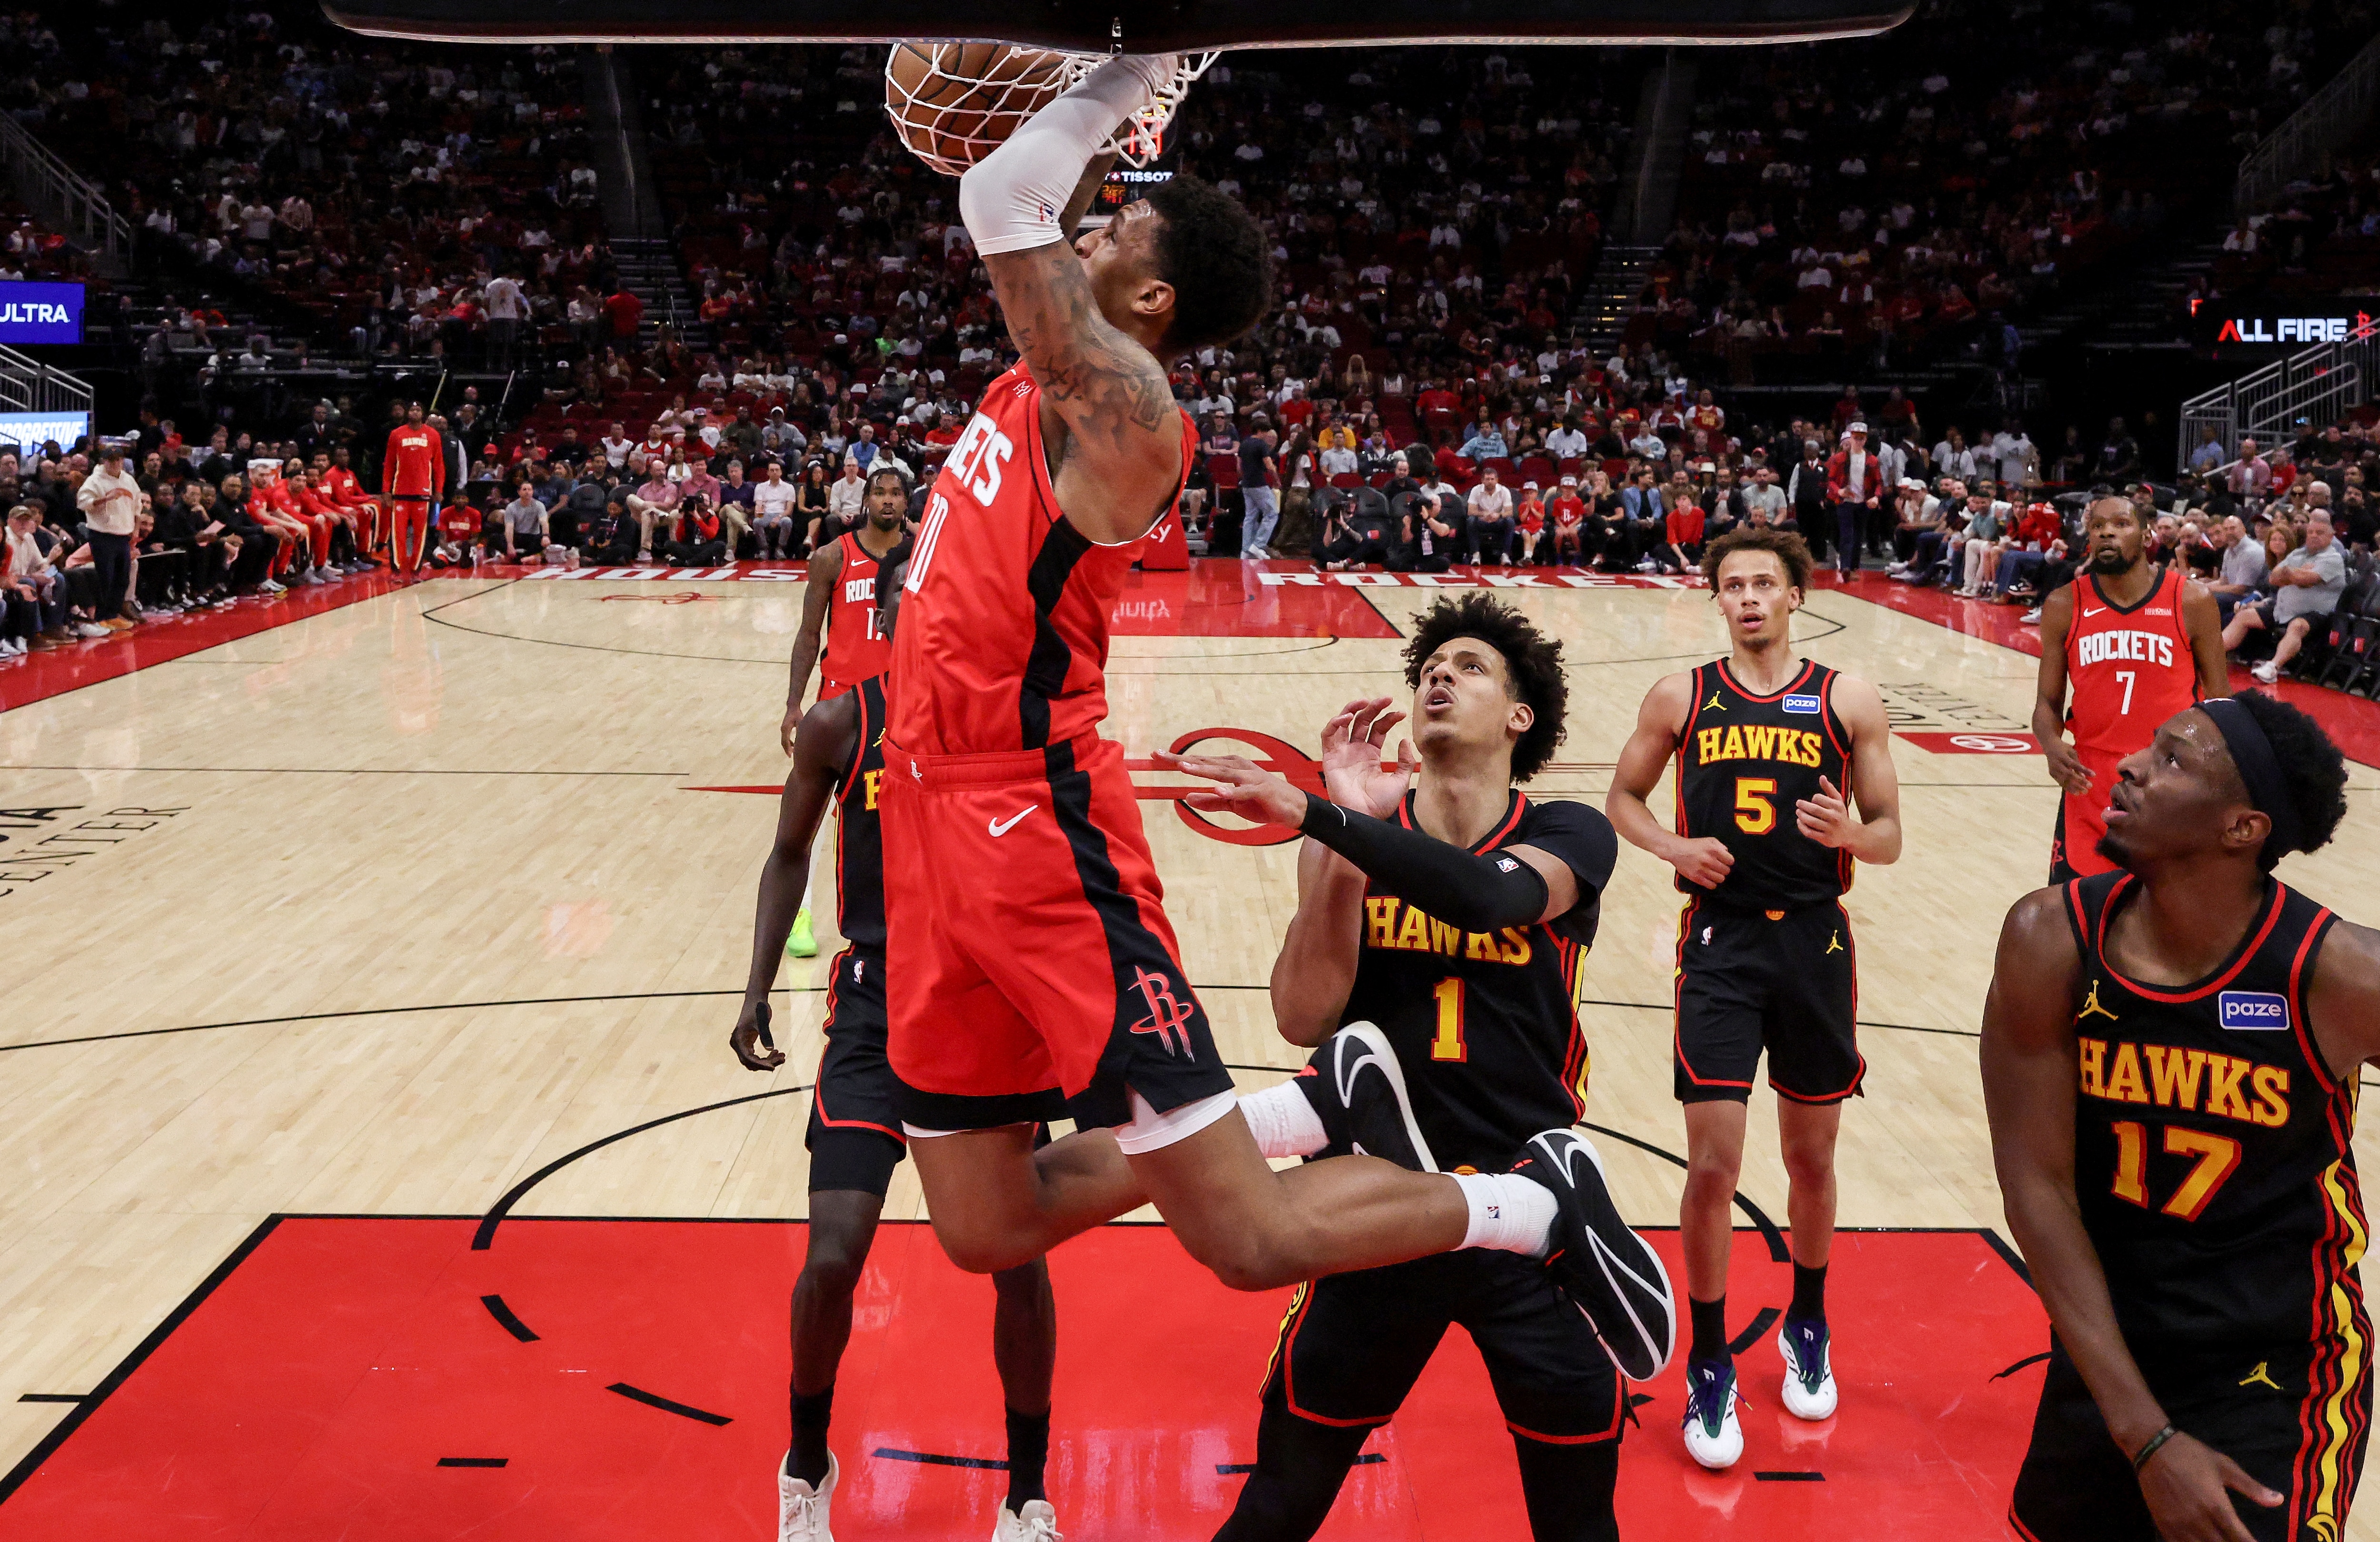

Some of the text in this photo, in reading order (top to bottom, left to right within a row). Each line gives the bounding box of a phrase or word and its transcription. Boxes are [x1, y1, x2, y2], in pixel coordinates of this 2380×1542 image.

[1121, 171, 1173, 182] TISSOT
[524, 568, 807, 582] HOUS
[846, 577, 876, 603] ROC
[1258, 573, 1709, 590] ROCKET
[867, 607, 883, 640] 1
[2078, 630, 2173, 667] ROCKETS
[1785, 698, 1817, 709] paze
[2116, 671, 2136, 715] 7
[1697, 725, 1822, 768] HAWKS
[1734, 777, 1777, 835] 5
[0, 806, 191, 898] ENTER
[1431, 976, 1467, 1063] 1
[2226, 1001, 2281, 1019] paze
[2079, 1037, 2290, 1128] HAWKS
[2110, 1120, 2241, 1222] 17
